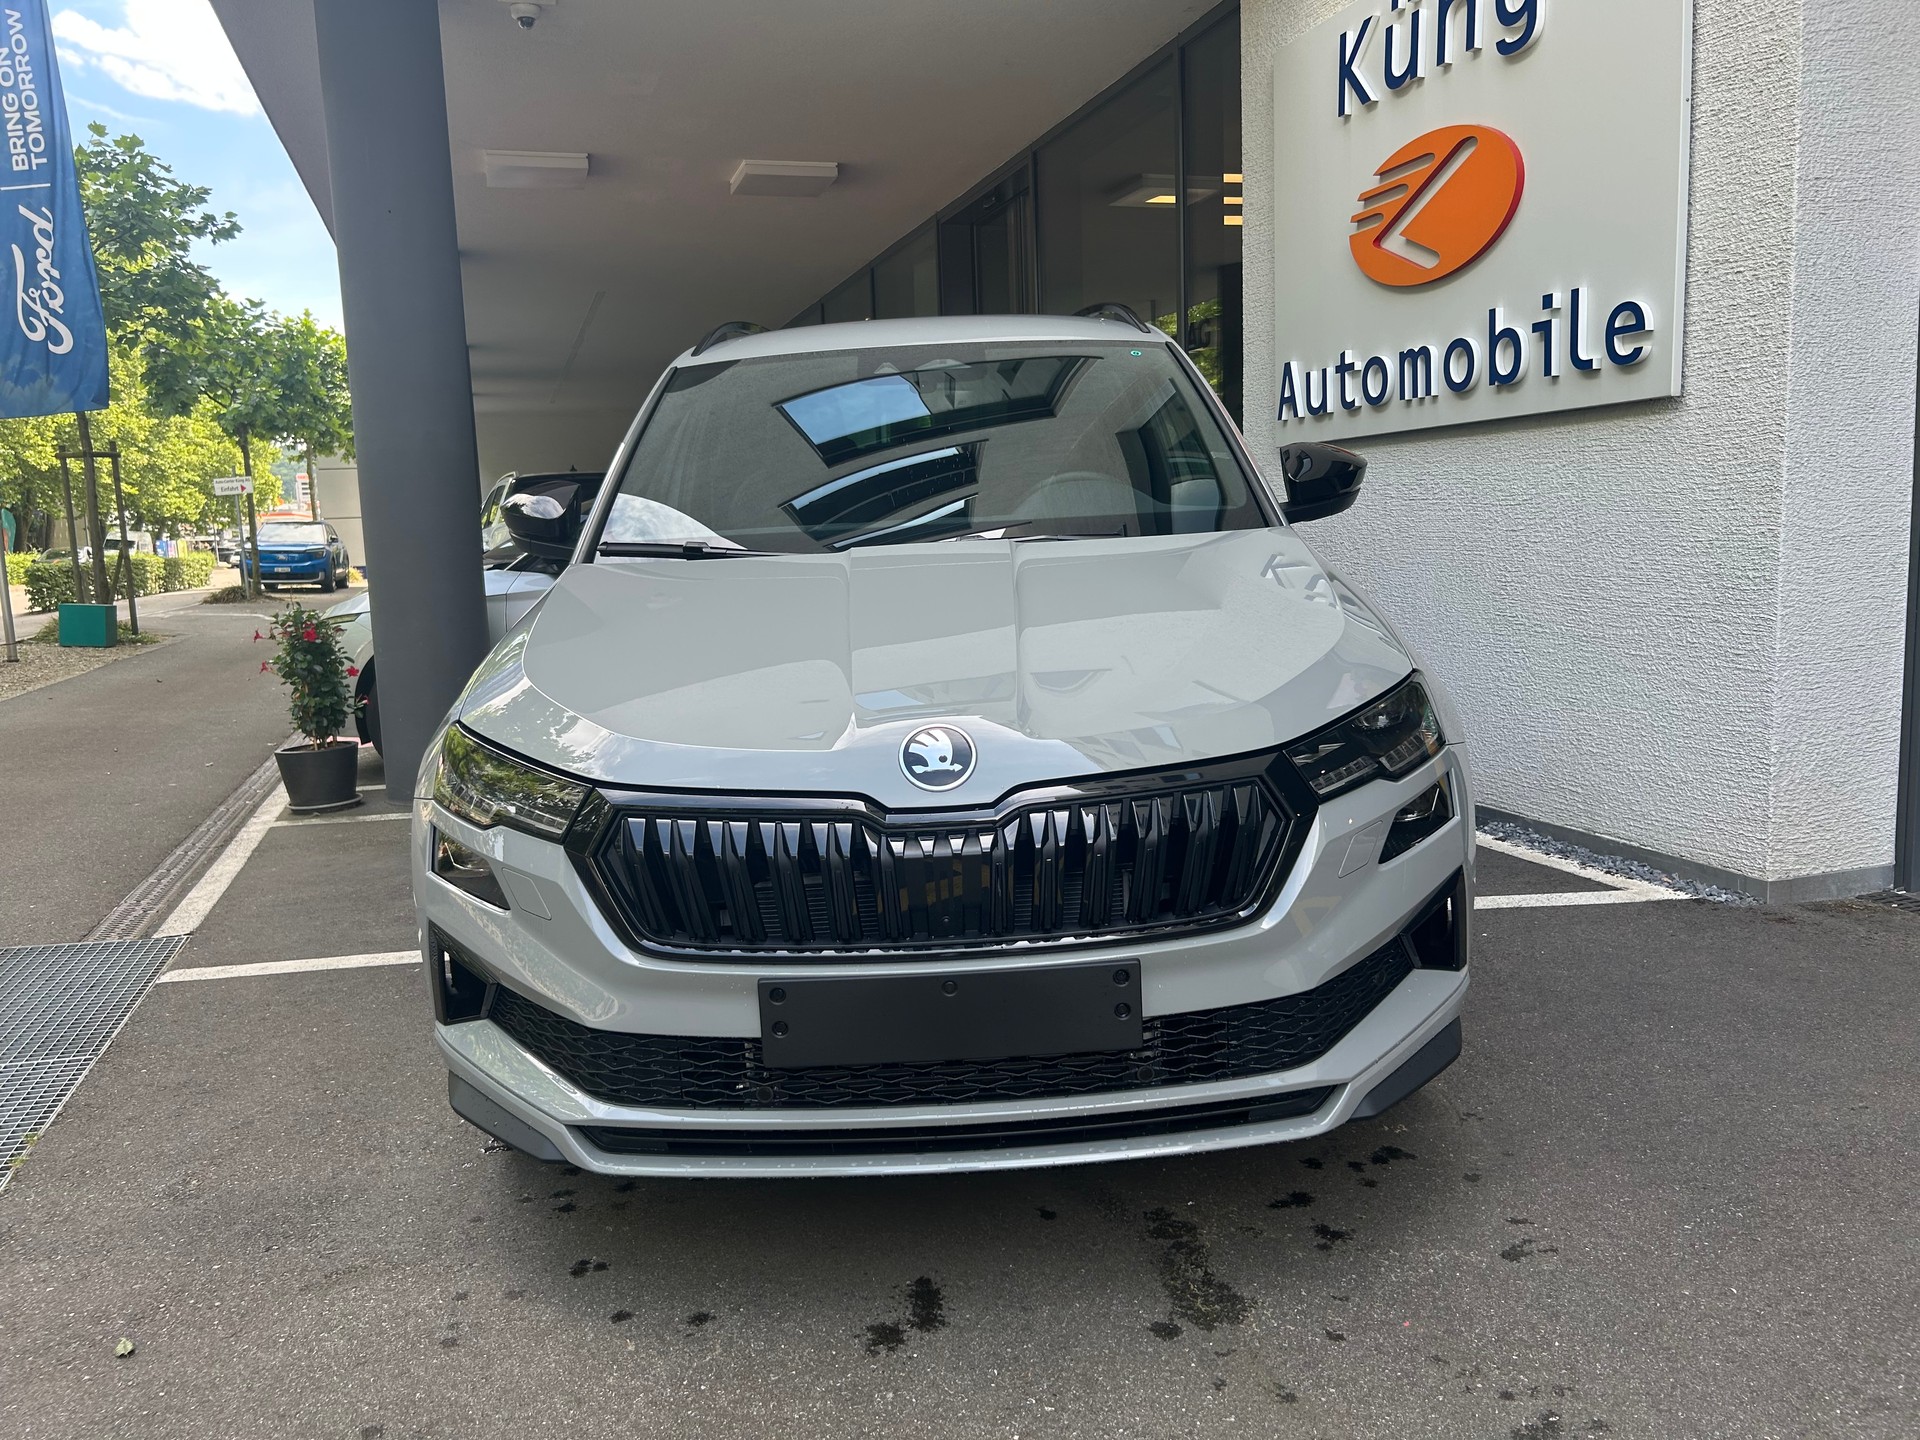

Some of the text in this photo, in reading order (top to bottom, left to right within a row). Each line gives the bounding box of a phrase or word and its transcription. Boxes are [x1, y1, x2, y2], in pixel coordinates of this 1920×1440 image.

[0, 47, 30, 171] BRING ON
[4, 8, 48, 171] TOMORROW
[1338, 0, 1545, 119] Küng
[12, 204, 74, 355] Ford
[1277, 287, 1655, 421] Automobile
